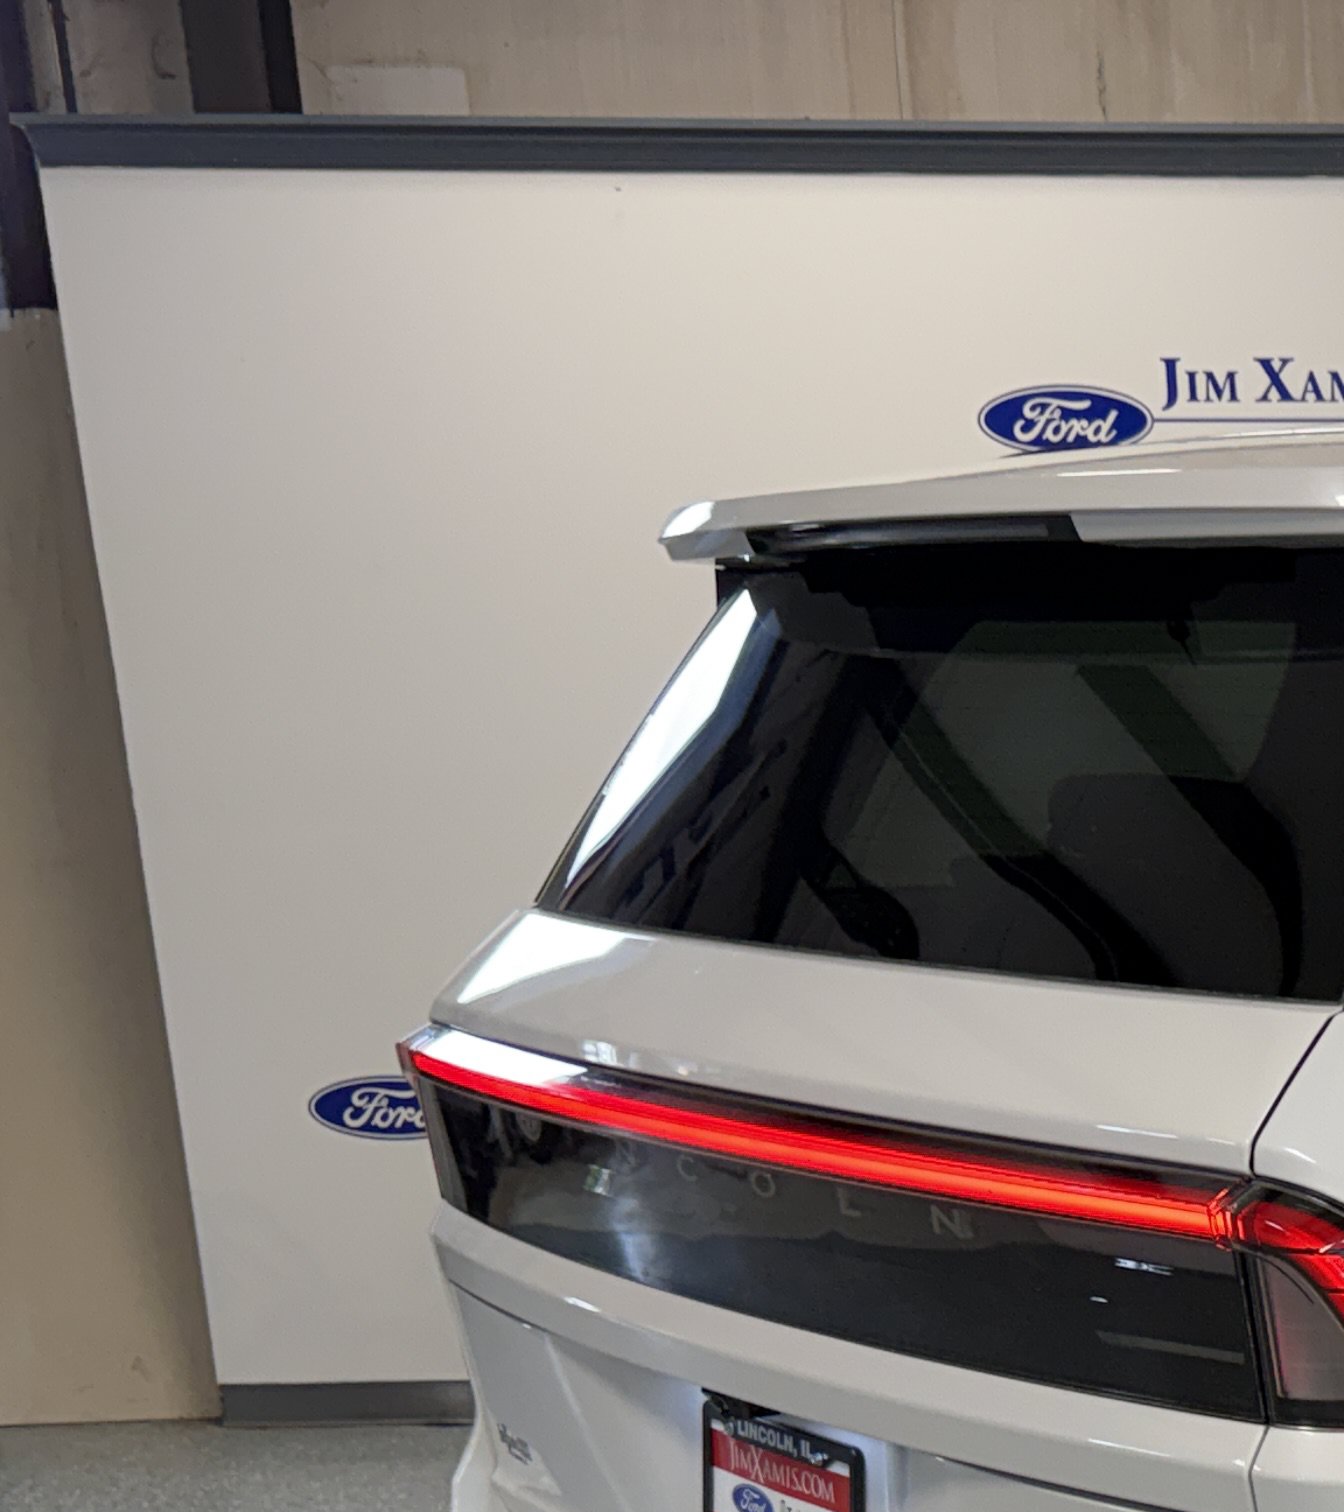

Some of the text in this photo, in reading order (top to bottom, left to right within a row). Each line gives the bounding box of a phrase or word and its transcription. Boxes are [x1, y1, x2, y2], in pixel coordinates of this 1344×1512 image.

[1159, 356, 1240, 411] JIM
[1013, 396, 1119, 444] Ford
[737, 1419, 798, 1457] LINCOLN,
